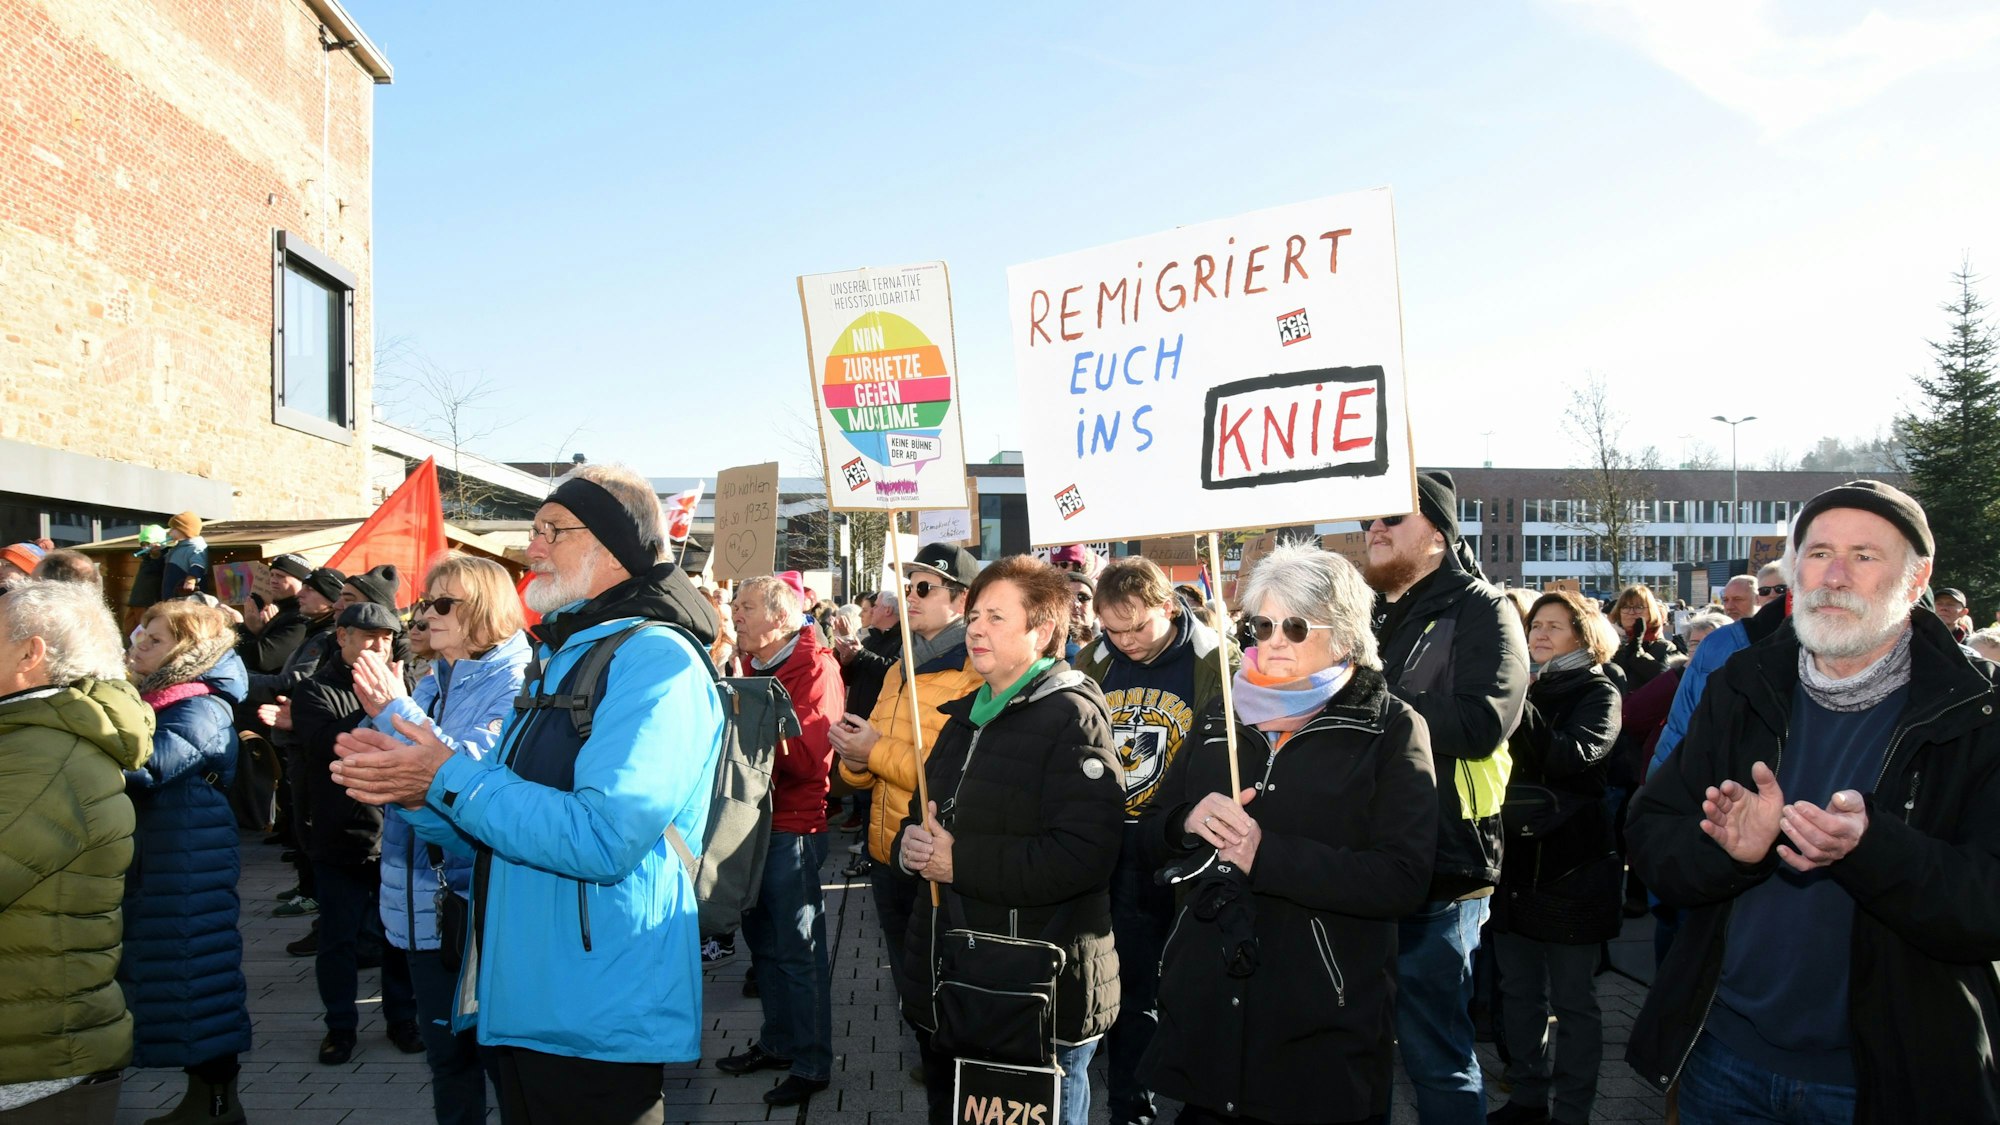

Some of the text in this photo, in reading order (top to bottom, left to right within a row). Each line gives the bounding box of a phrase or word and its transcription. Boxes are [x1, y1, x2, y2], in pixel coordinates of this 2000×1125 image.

[1278, 312, 1308, 332] FCK
[1282, 325, 1310, 343] AFD
[1070, 334, 1184, 394] EUCH
[891, 438, 932, 450] KEINE BÜHNE
[891, 449, 918, 460] DER AFD
[844, 461, 865, 479] FCK
[849, 471, 870, 488] AFD
[1056, 487, 1080, 508] FCK
[744, 502, 770, 524] 1933
[1062, 498, 1083, 518] AFD
[1158, 690, 1193, 731] YEARS
[964, 1095, 1048, 1125] NAZIS
